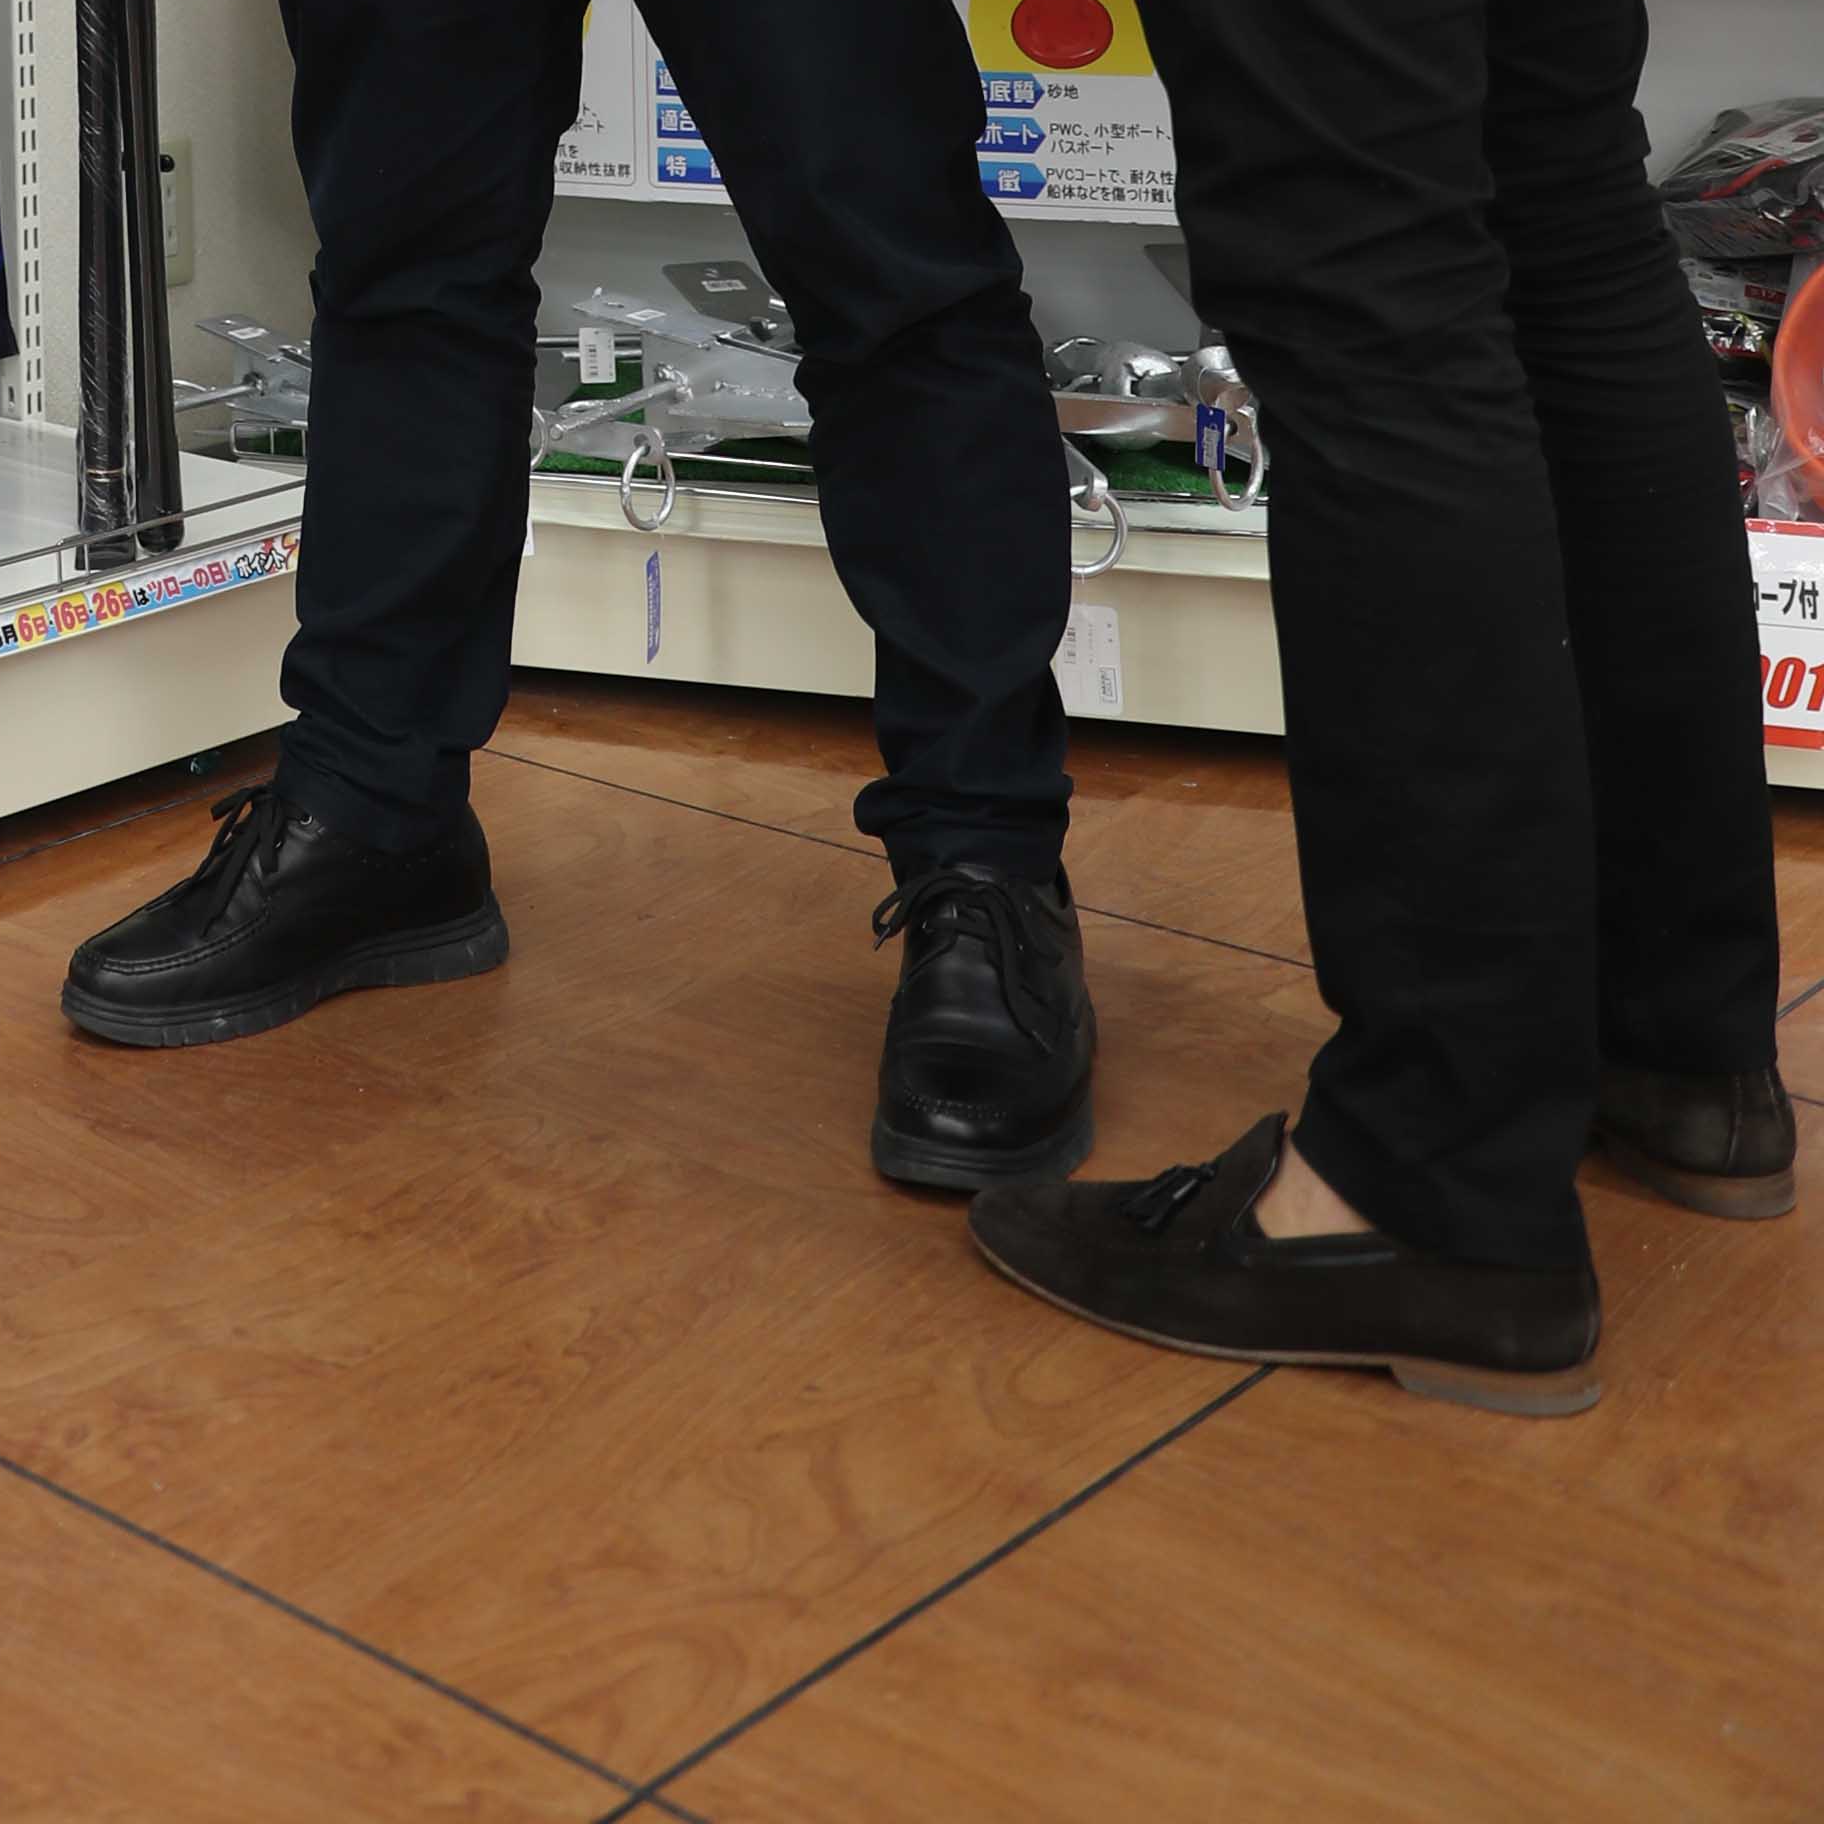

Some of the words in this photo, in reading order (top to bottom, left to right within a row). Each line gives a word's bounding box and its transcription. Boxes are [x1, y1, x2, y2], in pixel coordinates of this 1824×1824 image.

[1046, 83, 1080, 102] 砂地
[558, 160, 632, 178] 収納性抜群
